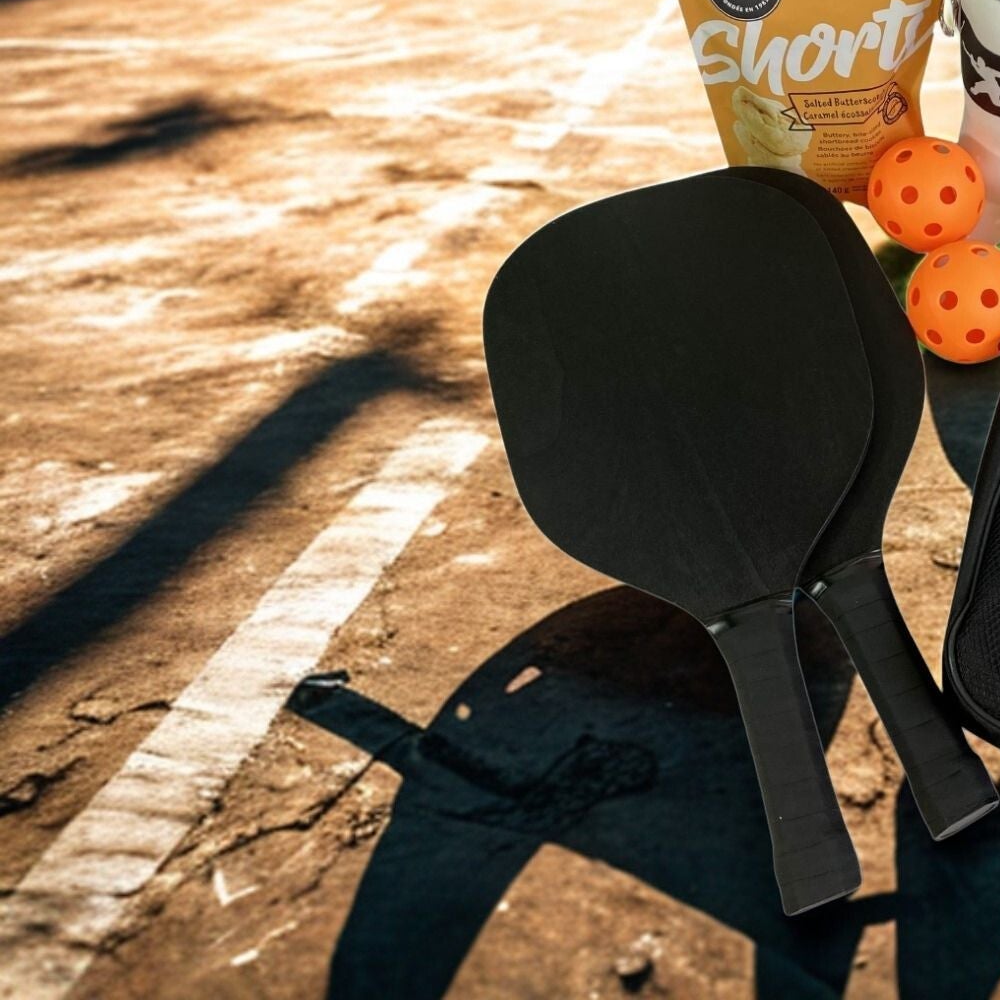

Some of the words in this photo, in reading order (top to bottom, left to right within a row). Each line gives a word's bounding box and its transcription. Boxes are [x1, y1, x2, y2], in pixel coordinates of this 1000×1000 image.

[803, 97, 832, 108] Salted
[835, 89, 885, 106] Butterscot
[803, 110, 839, 121] Caramel
